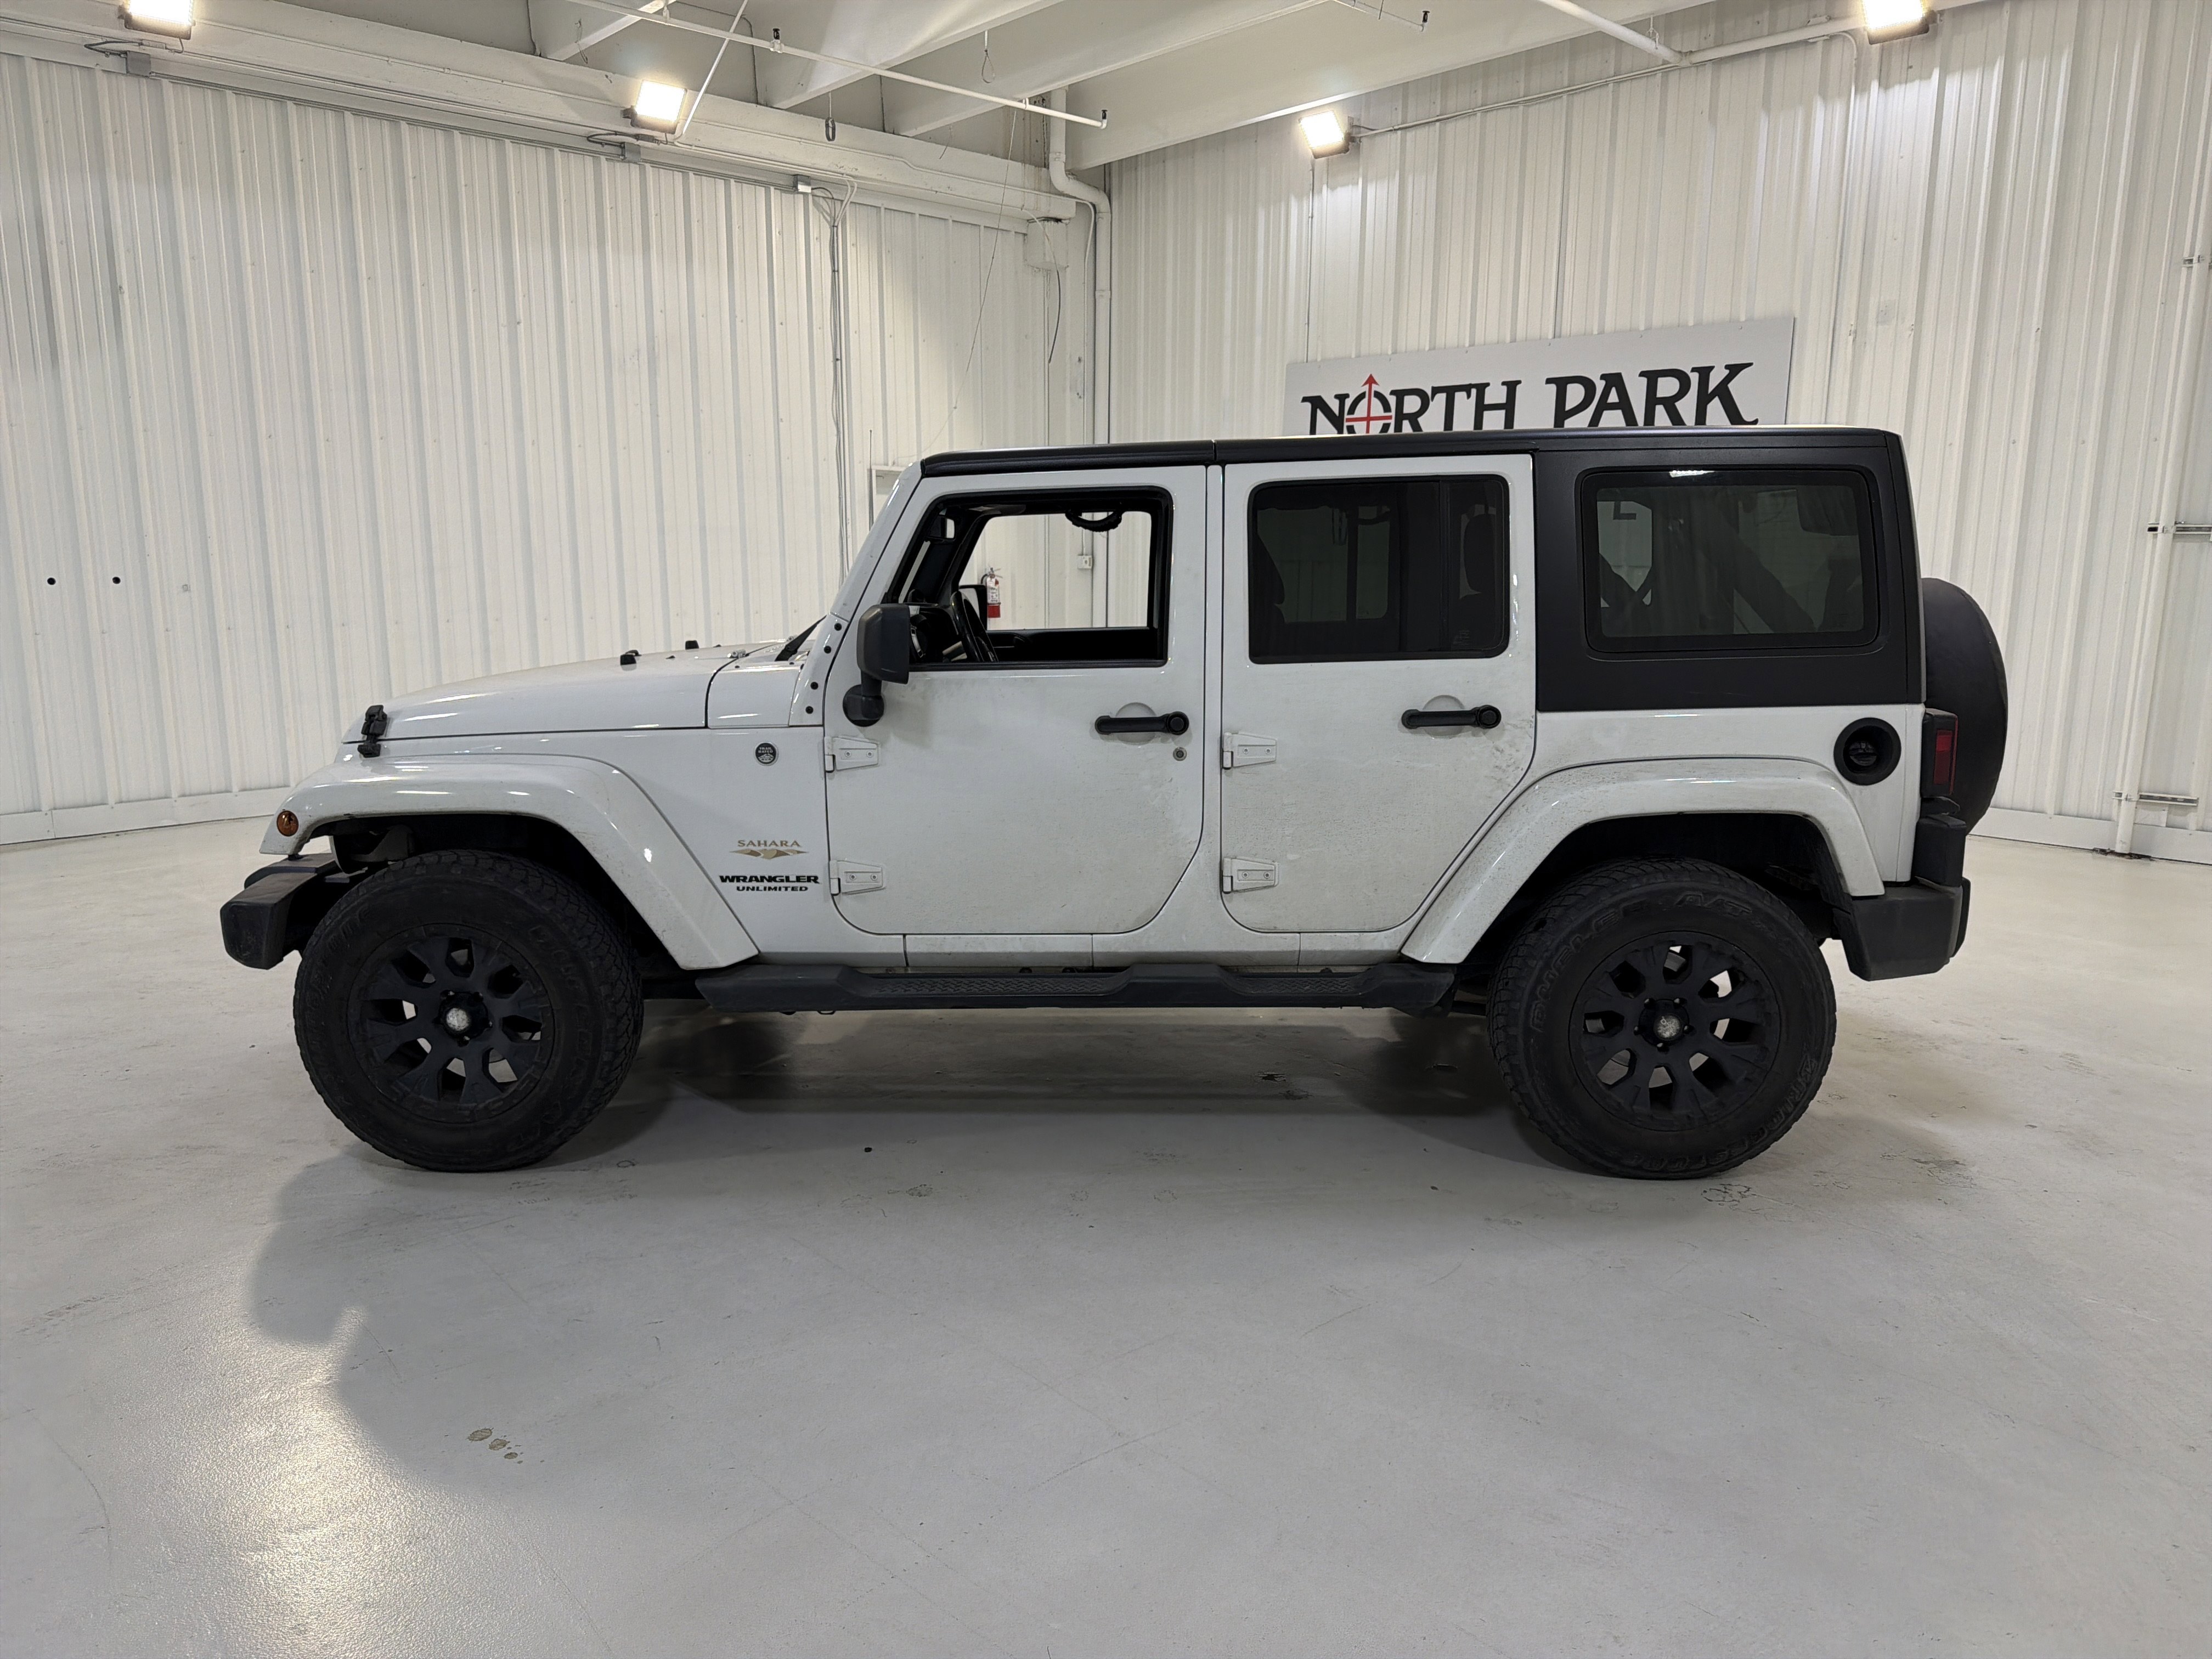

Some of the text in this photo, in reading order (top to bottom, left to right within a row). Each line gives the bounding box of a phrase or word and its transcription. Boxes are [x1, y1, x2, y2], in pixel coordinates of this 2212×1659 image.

[1301, 362, 1759, 435] NORTH PARK
[719, 876, 820, 884] WRANGLER
